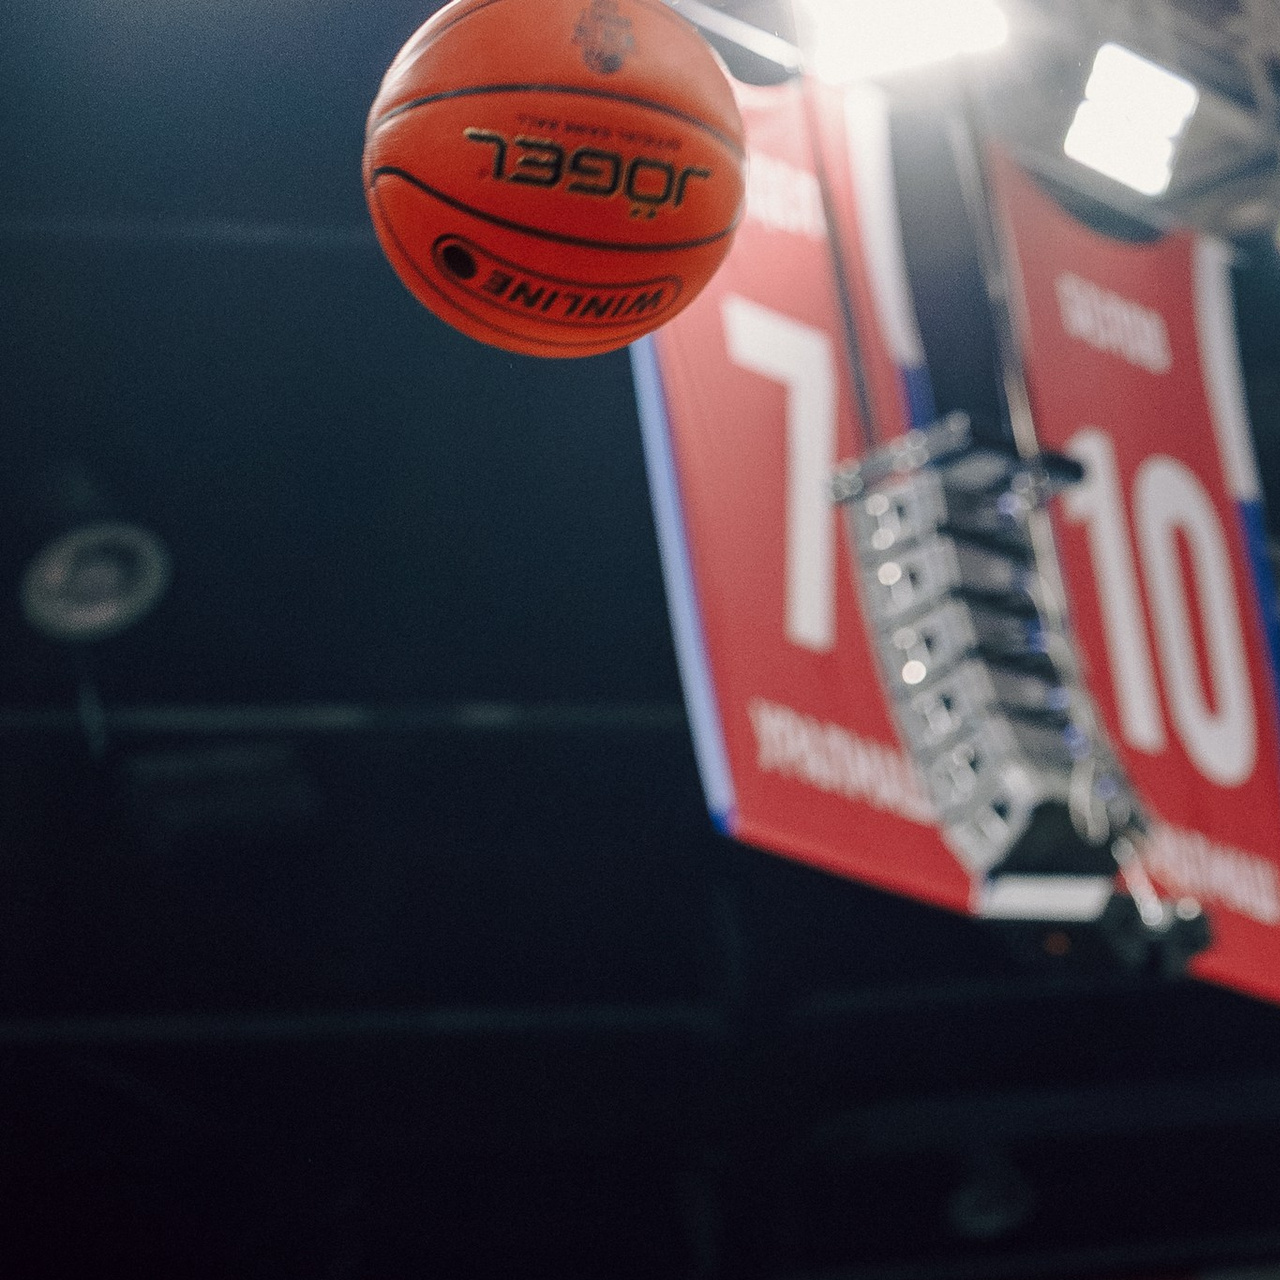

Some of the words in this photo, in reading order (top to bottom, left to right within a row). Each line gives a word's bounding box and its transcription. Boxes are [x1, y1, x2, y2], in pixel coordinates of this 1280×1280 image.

[463, 127, 714, 221] JÖGEL
[483, 268, 664, 318] WINLINE
[721, 292, 837, 654] 7
[1062, 427, 1258, 787] 10
